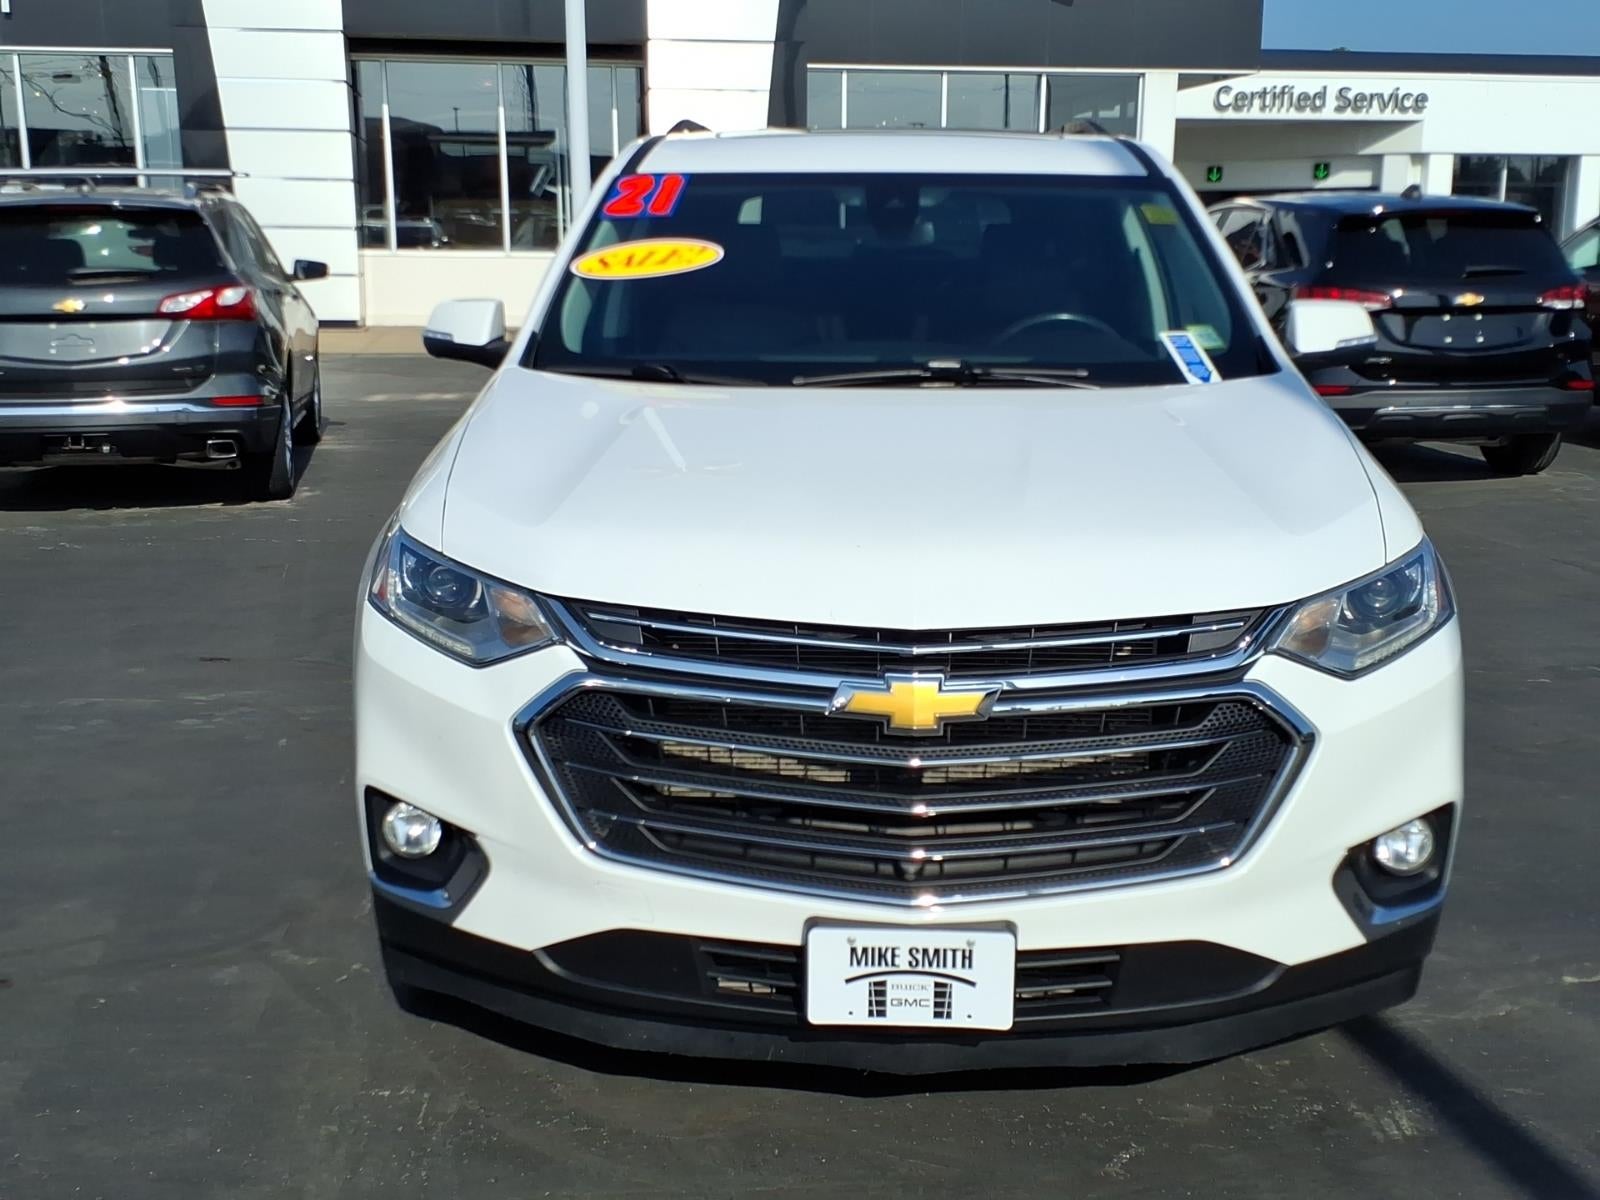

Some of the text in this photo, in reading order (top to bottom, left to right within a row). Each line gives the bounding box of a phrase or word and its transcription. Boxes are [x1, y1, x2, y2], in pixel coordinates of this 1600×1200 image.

[1214, 84, 1429, 113] Certified Service
[603, 173, 684, 217] 21
[849, 947, 973, 969] MIKE SMITH
[890, 998, 930, 1007] GMC
